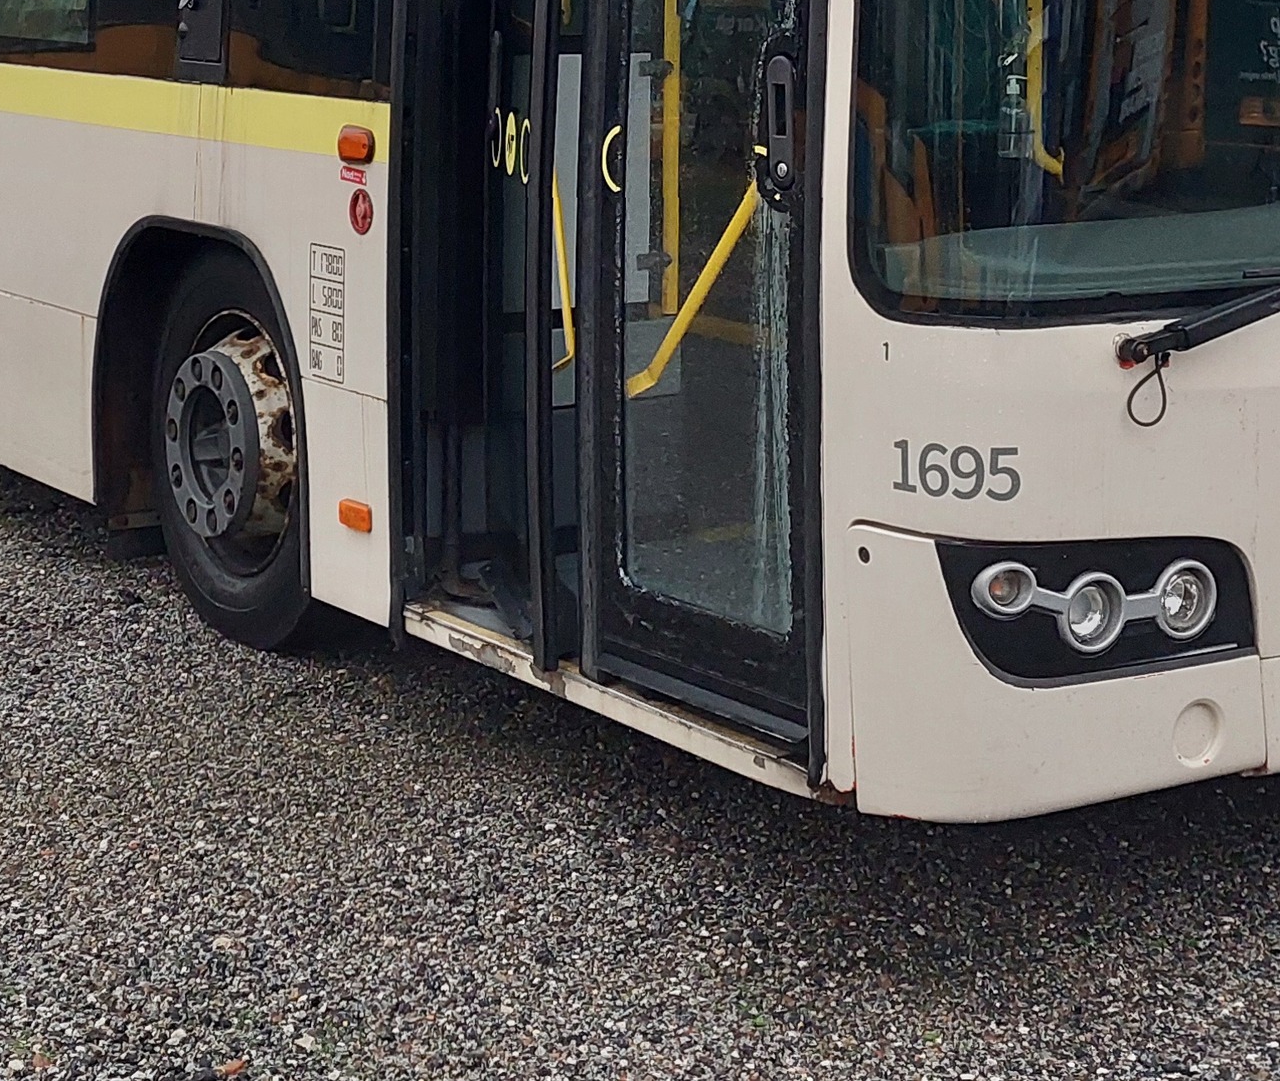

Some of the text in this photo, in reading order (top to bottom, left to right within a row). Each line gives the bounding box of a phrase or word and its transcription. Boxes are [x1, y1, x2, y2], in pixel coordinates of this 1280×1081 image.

[312, 250, 343, 277] T 17800
[312, 283, 343, 310] L 5800
[311, 316, 343, 343] PAS 80
[311, 349, 322, 370] BAG
[882, 341, 889, 361] 1
[893, 439, 1021, 501] 1695
